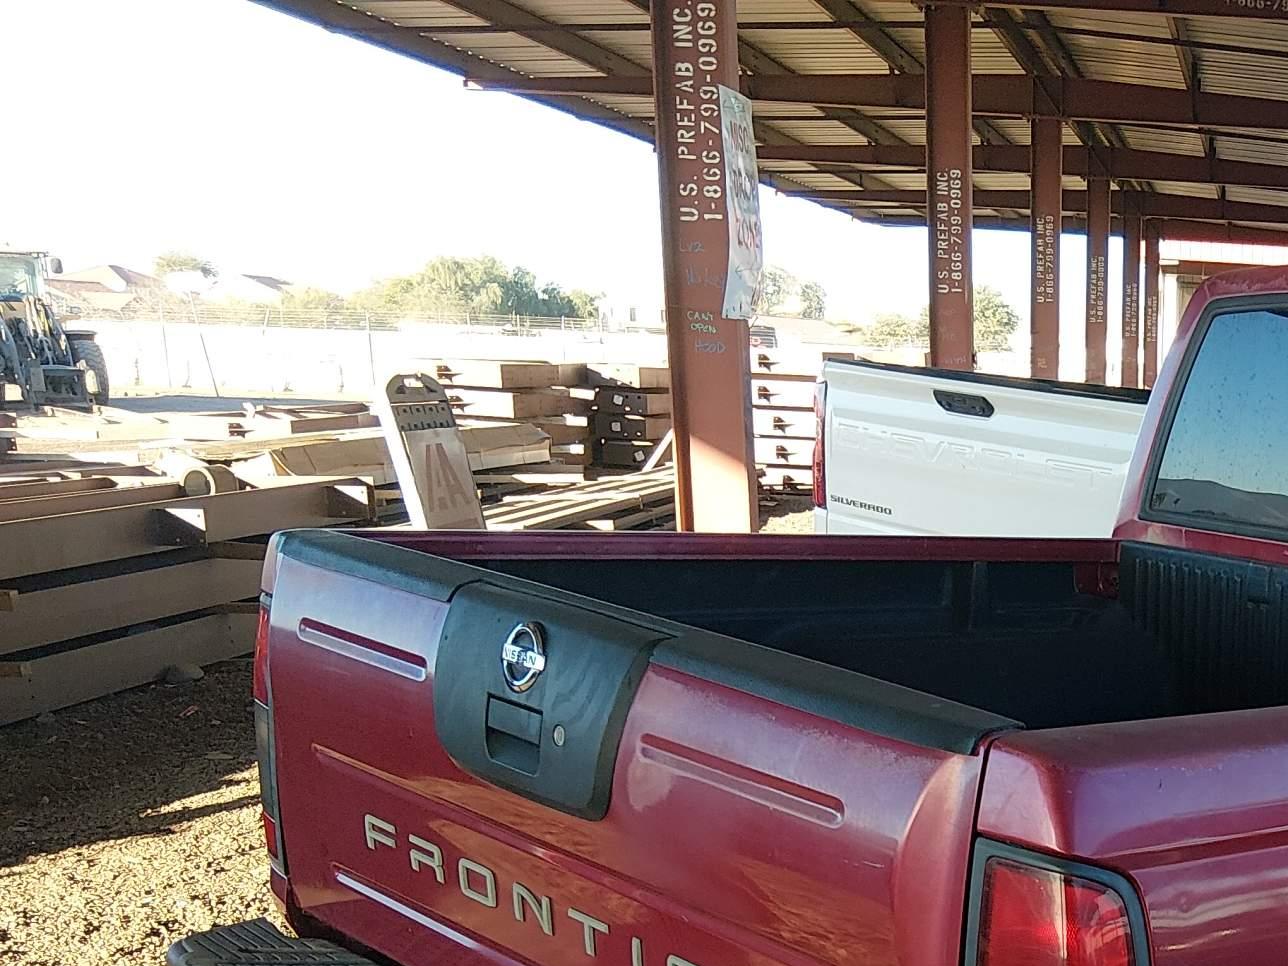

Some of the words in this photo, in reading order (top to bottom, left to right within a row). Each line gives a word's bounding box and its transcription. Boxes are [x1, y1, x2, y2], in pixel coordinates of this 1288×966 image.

[672, 0, 694, 48] INC.
[675, 61, 697, 160] PREFAB
[696, 2, 724, 221] 1-866-799-0969
[680, 175, 699, 222] U.S.
[936, 168, 949, 195] INC.
[936, 202, 949, 258] PREFAB
[950, 169, 963, 293] 1-866-799-0969
[938, 266, 949, 294] U.S.
[830, 494, 892, 516] SILVERADO
